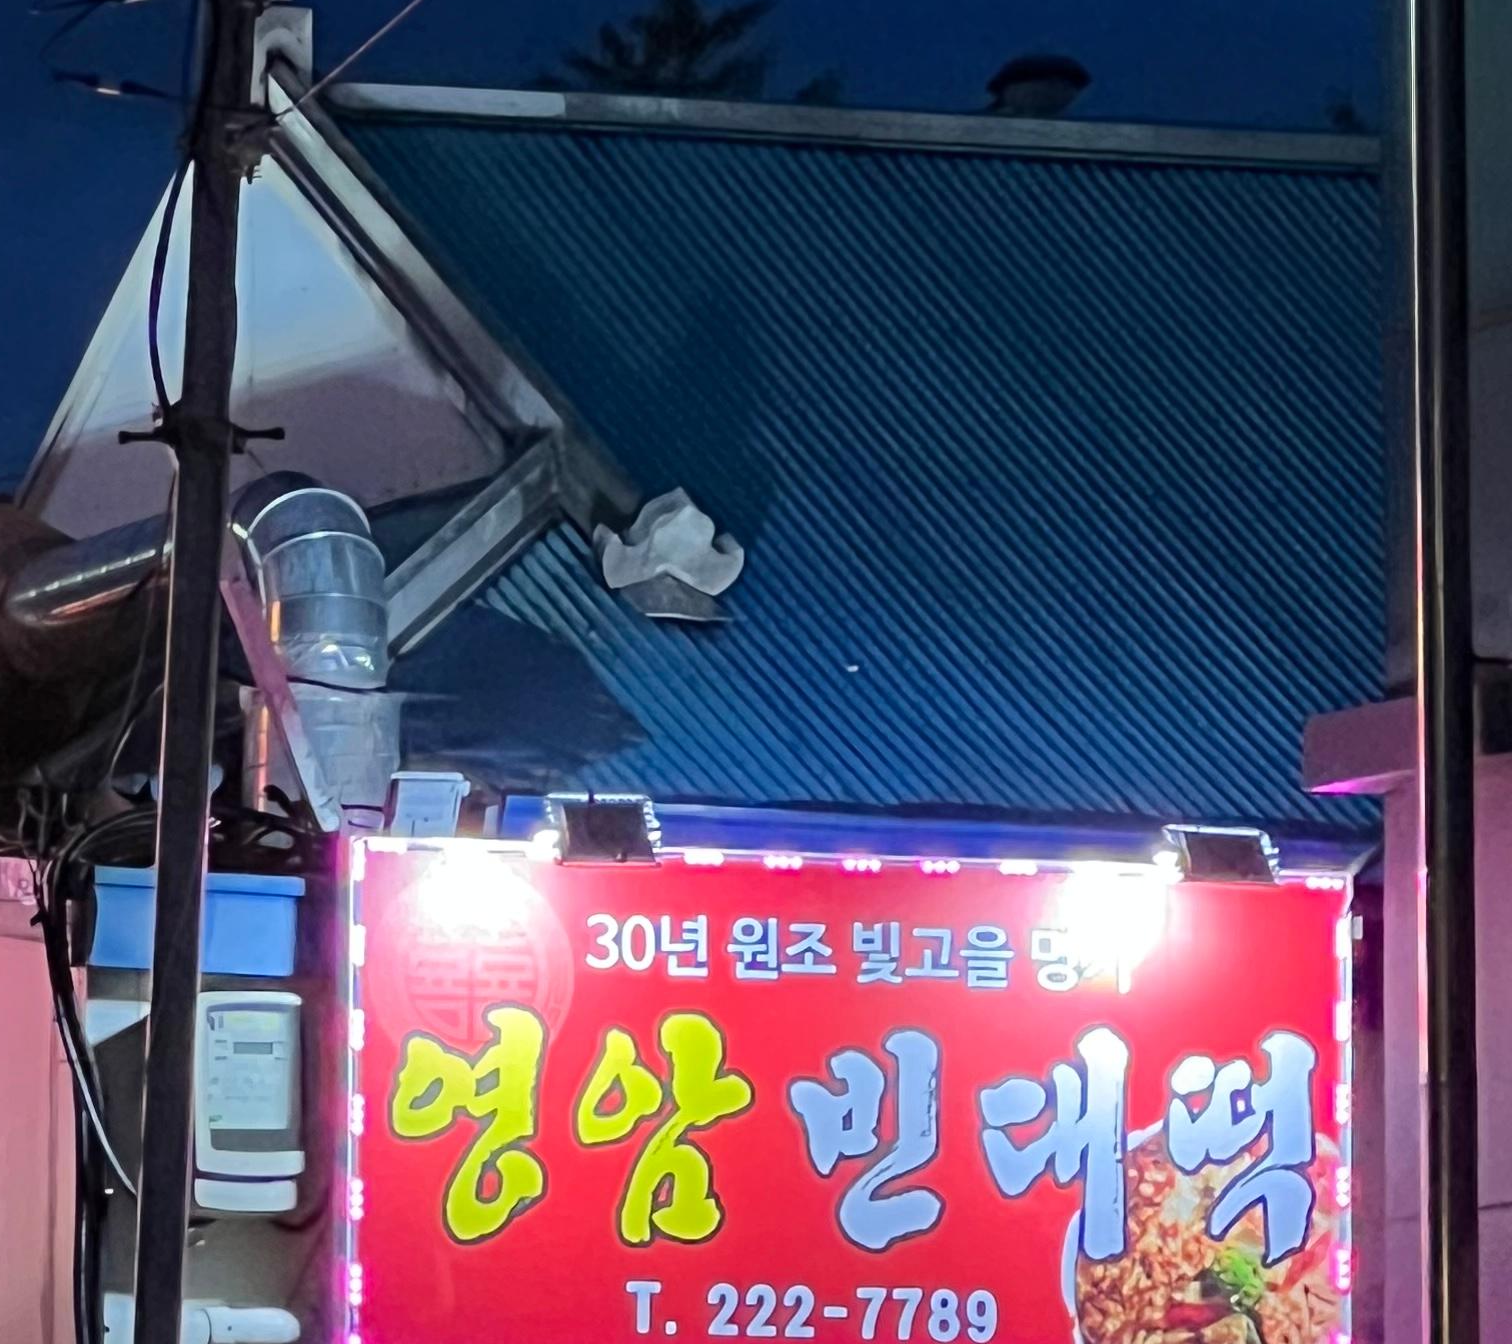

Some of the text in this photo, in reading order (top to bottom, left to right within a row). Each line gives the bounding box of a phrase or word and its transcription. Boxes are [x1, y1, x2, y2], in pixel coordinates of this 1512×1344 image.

[585, 913, 708, 978] 30년
[727, 917, 837, 980] 원조
[852, 920, 1015, 989] 빛고을
[391, 1006, 752, 1244] 영암
[789, 1027, 1317, 1264] 빈대떡
[625, 1280, 999, 1344] T. 222-7789
